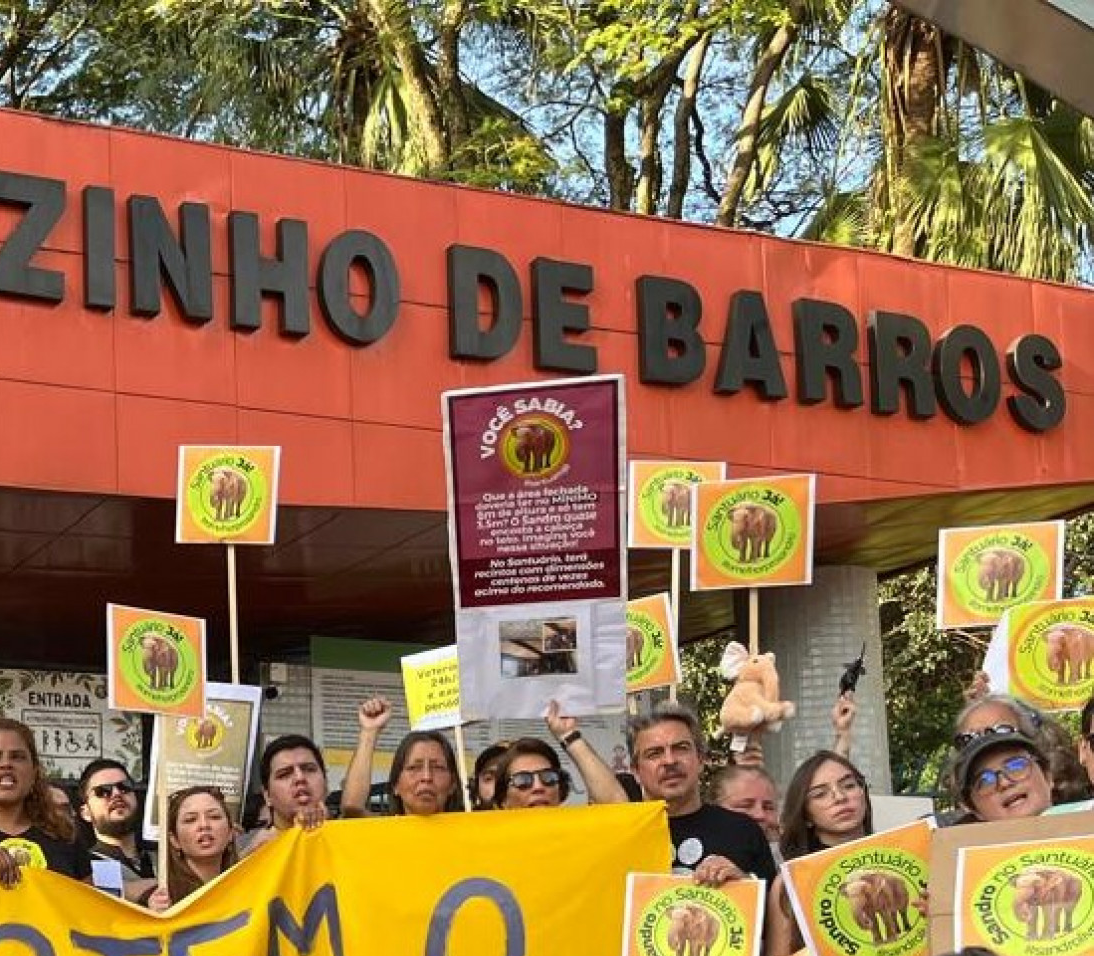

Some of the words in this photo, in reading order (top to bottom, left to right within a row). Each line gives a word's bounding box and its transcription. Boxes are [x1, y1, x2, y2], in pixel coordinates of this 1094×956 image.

[447, 244, 598, 373] DE
[637, 274, 1066, 432] BARROS
[480, 404, 514, 460] VOCÊ
[514, 397, 584, 431] SABIA?
[510, 517, 520, 526] O
[707, 490, 760, 532] Santuário
[761, 489, 785, 506] Já!
[480, 538, 494, 546] no
[490, 559, 504, 568] No
[518, 566, 543, 575] com
[541, 575, 557, 583] de
[28, 692, 92, 709] ENTRADA
[841, 850, 922, 882] Santuário
[823, 873, 842, 895] no
[656, 896, 673, 913] no
[675, 887, 736, 925] Santuário
[973, 884, 1010, 945] Sandro
[992, 863, 1017, 884] no
[818, 897, 861, 956] Sandro
